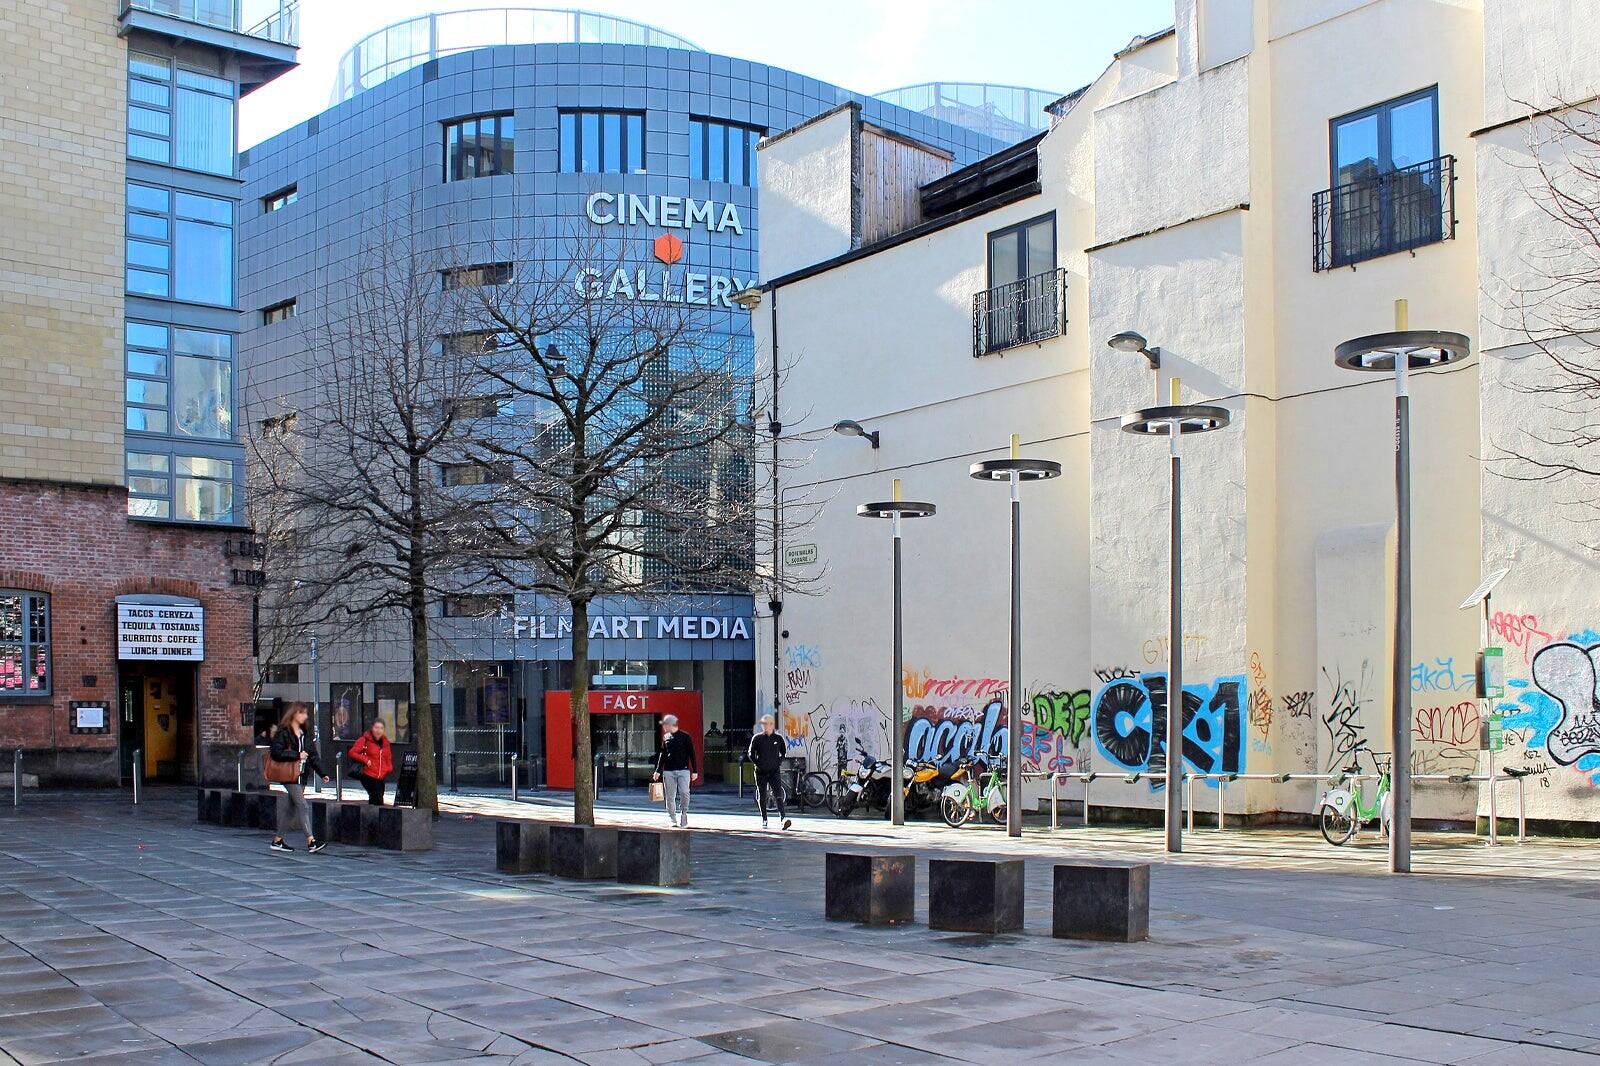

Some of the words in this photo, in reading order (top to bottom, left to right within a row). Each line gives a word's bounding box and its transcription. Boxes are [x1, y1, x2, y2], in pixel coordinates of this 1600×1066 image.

[586, 192, 744, 236] CINEMA
[574, 267, 757, 309] GALLERY
[128, 609, 154, 617] TACOS
[158, 610, 194, 619] CERVEZA
[121, 621, 156, 631] TEQUILA
[160, 622, 200, 632] TOSTADAS
[588, 616, 650, 639] ART
[657, 616, 750, 639] MEDIA
[122, 634, 163, 643] BURRITOS
[167, 635, 198, 644] COFFEE
[131, 646, 158, 655] LUNCH
[162, 647, 192, 656] DINNER
[603, 694, 649, 710] FACT
